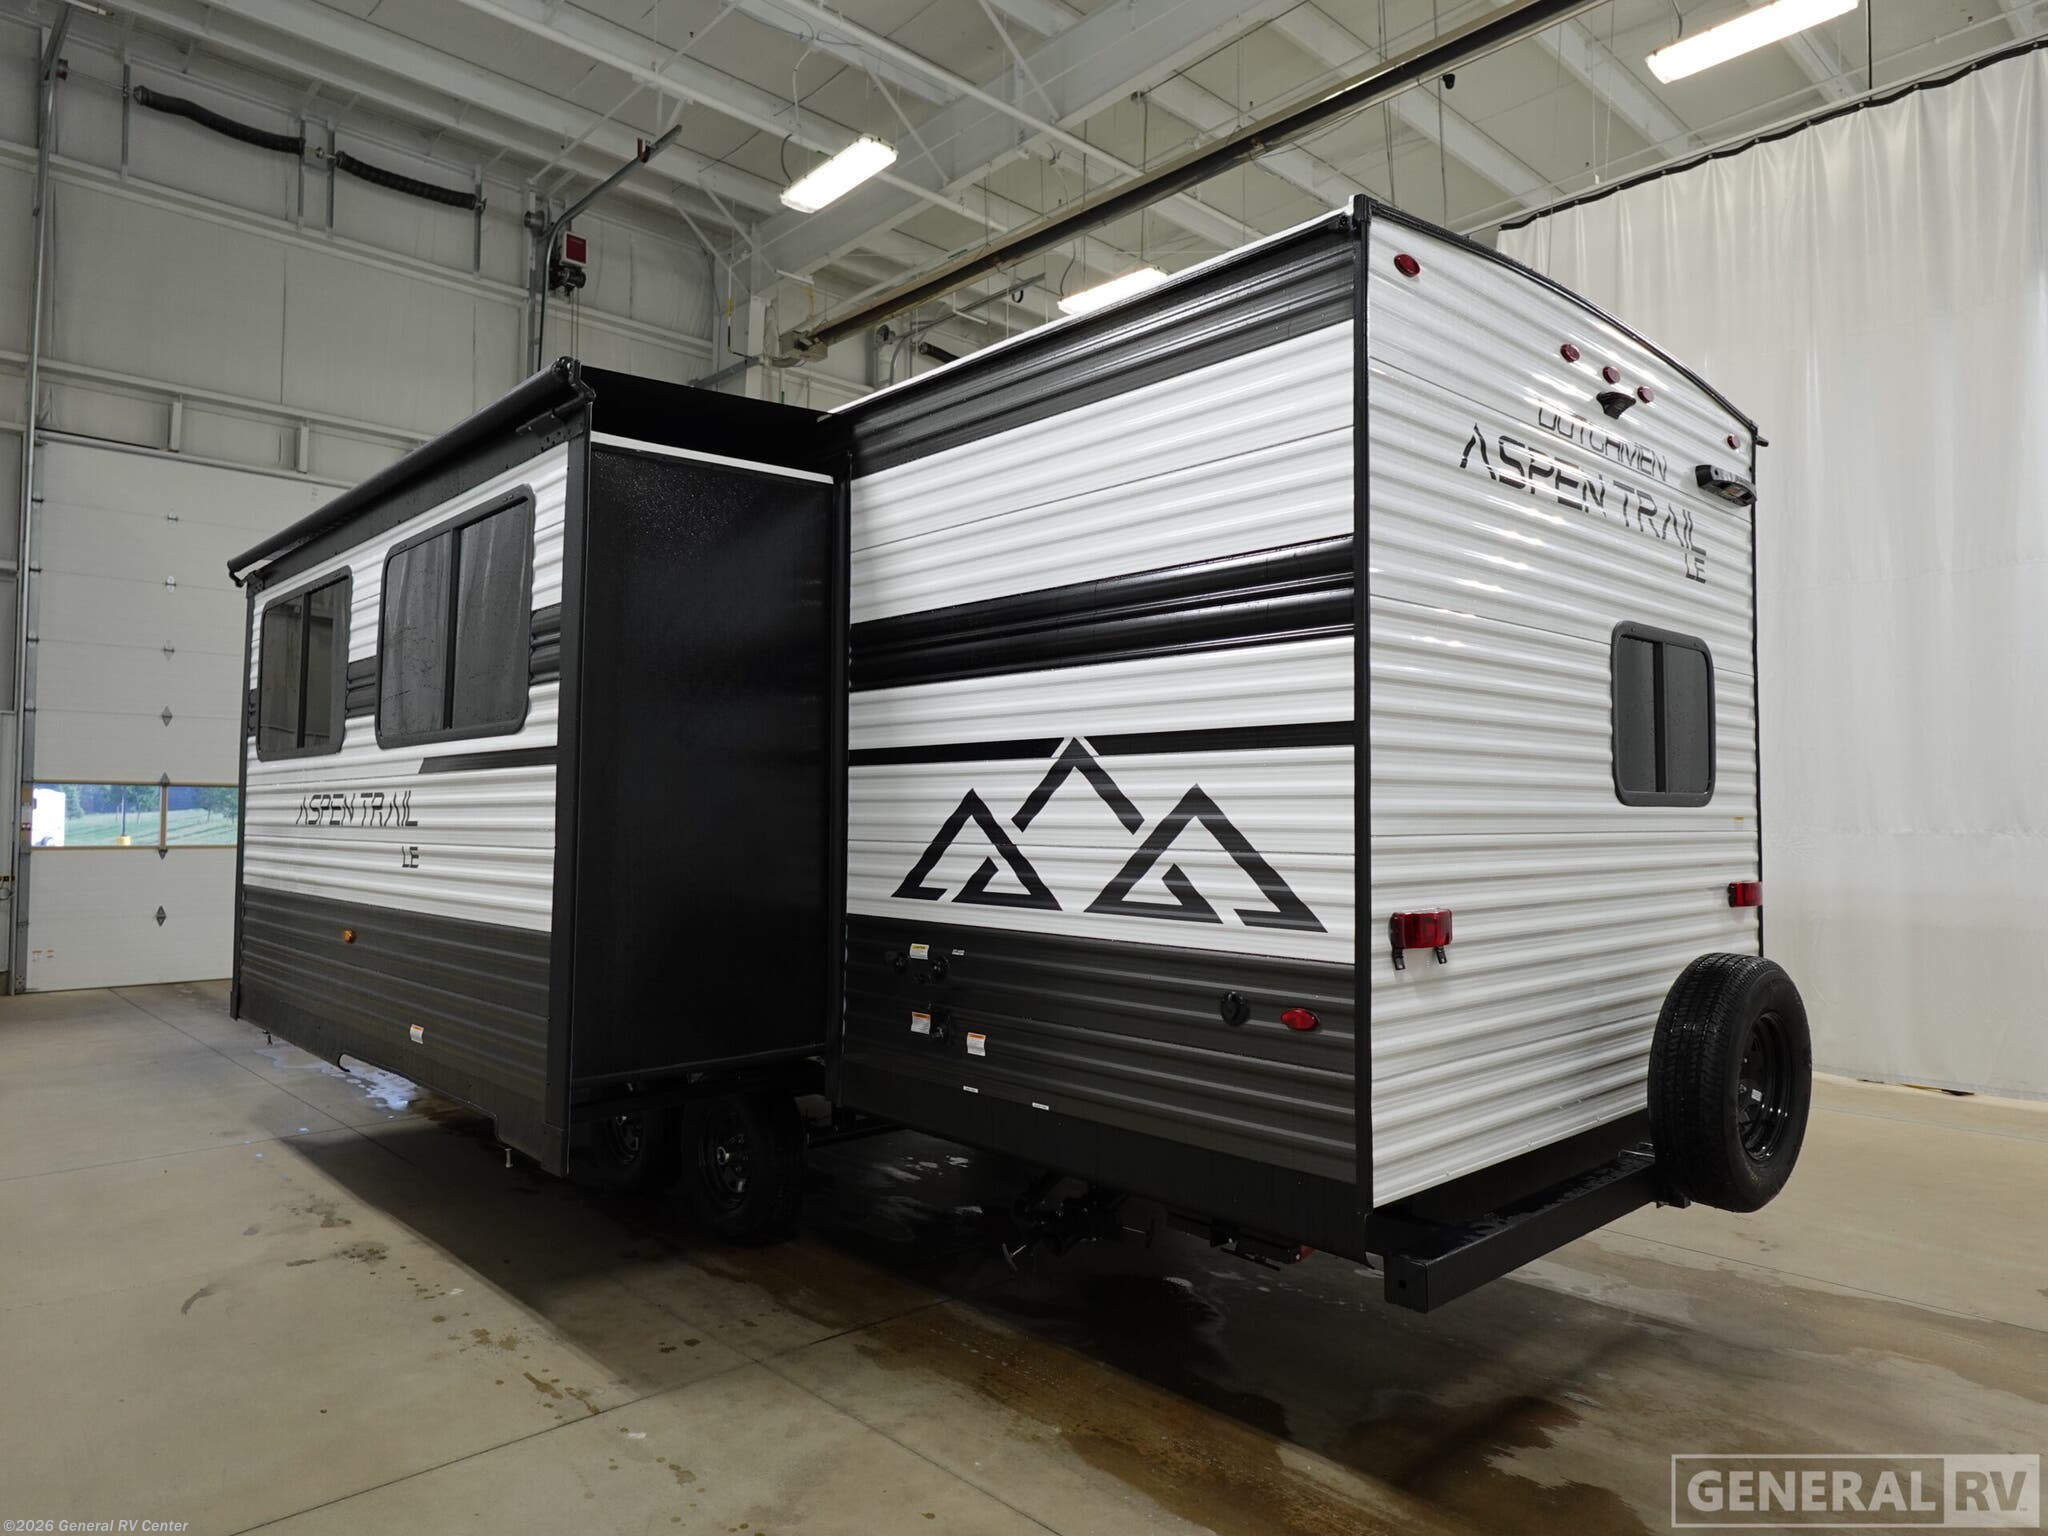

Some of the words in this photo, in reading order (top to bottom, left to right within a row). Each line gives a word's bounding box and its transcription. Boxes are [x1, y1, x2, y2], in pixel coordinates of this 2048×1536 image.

[1459, 422, 1607, 518] ASPEN
[1613, 480, 1707, 557] TRAIL
[1685, 552, 1706, 584] LE
[296, 792, 355, 826] ASPEN
[360, 790, 418, 827] TRAIL
[402, 845, 419, 868] LE
